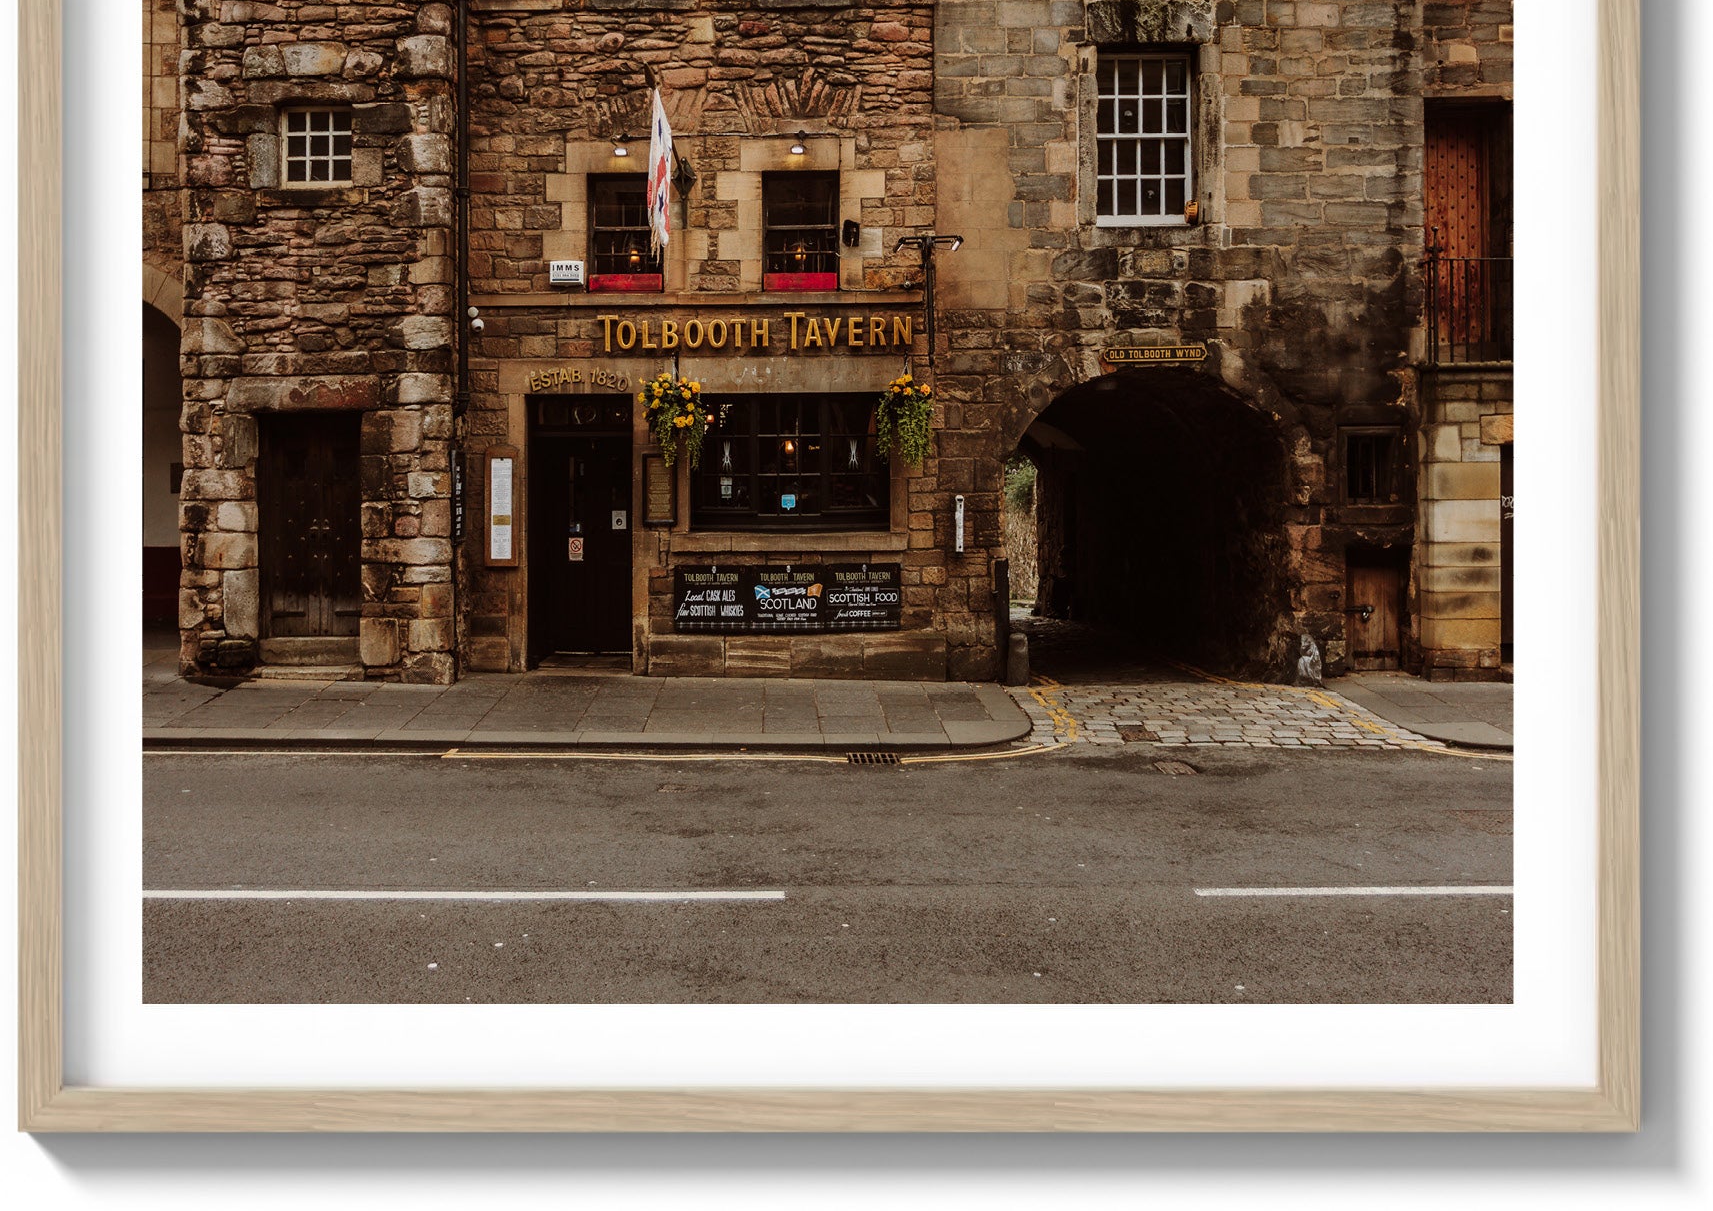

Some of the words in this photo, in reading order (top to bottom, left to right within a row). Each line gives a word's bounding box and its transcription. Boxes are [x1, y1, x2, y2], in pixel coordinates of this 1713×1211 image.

[552, 264, 580, 272] IMMS
[597, 314, 769, 353] TOLBOOTH
[783, 311, 912, 350] TAVERN
[1109, 351, 1125, 359] OLD
[1129, 350, 1171, 359] TOLBOOTH
[1176, 348, 1201, 358] WYND
[530, 368, 585, 392] ESTAB.
[590, 369, 629, 392] 1820
[684, 573, 714, 582] TOLBOOTH
[716, 573, 739, 582] TAVERN
[760, 572, 789, 582] TOLBOOTH
[793, 572, 815, 581] TAVERN
[835, 572, 866, 581] TOLBOOTH
[868, 571, 891, 580] TAVERN
[706, 589, 721, 602] CASK
[722, 589, 736, 602] ALES
[829, 593, 870, 603] SCOTTISH
[875, 592, 898, 602] FOOD
[760, 598, 817, 610] SCOTLAND
[690, 605, 716, 617] SCOTTISH
[849, 610, 872, 618] COFFEE
